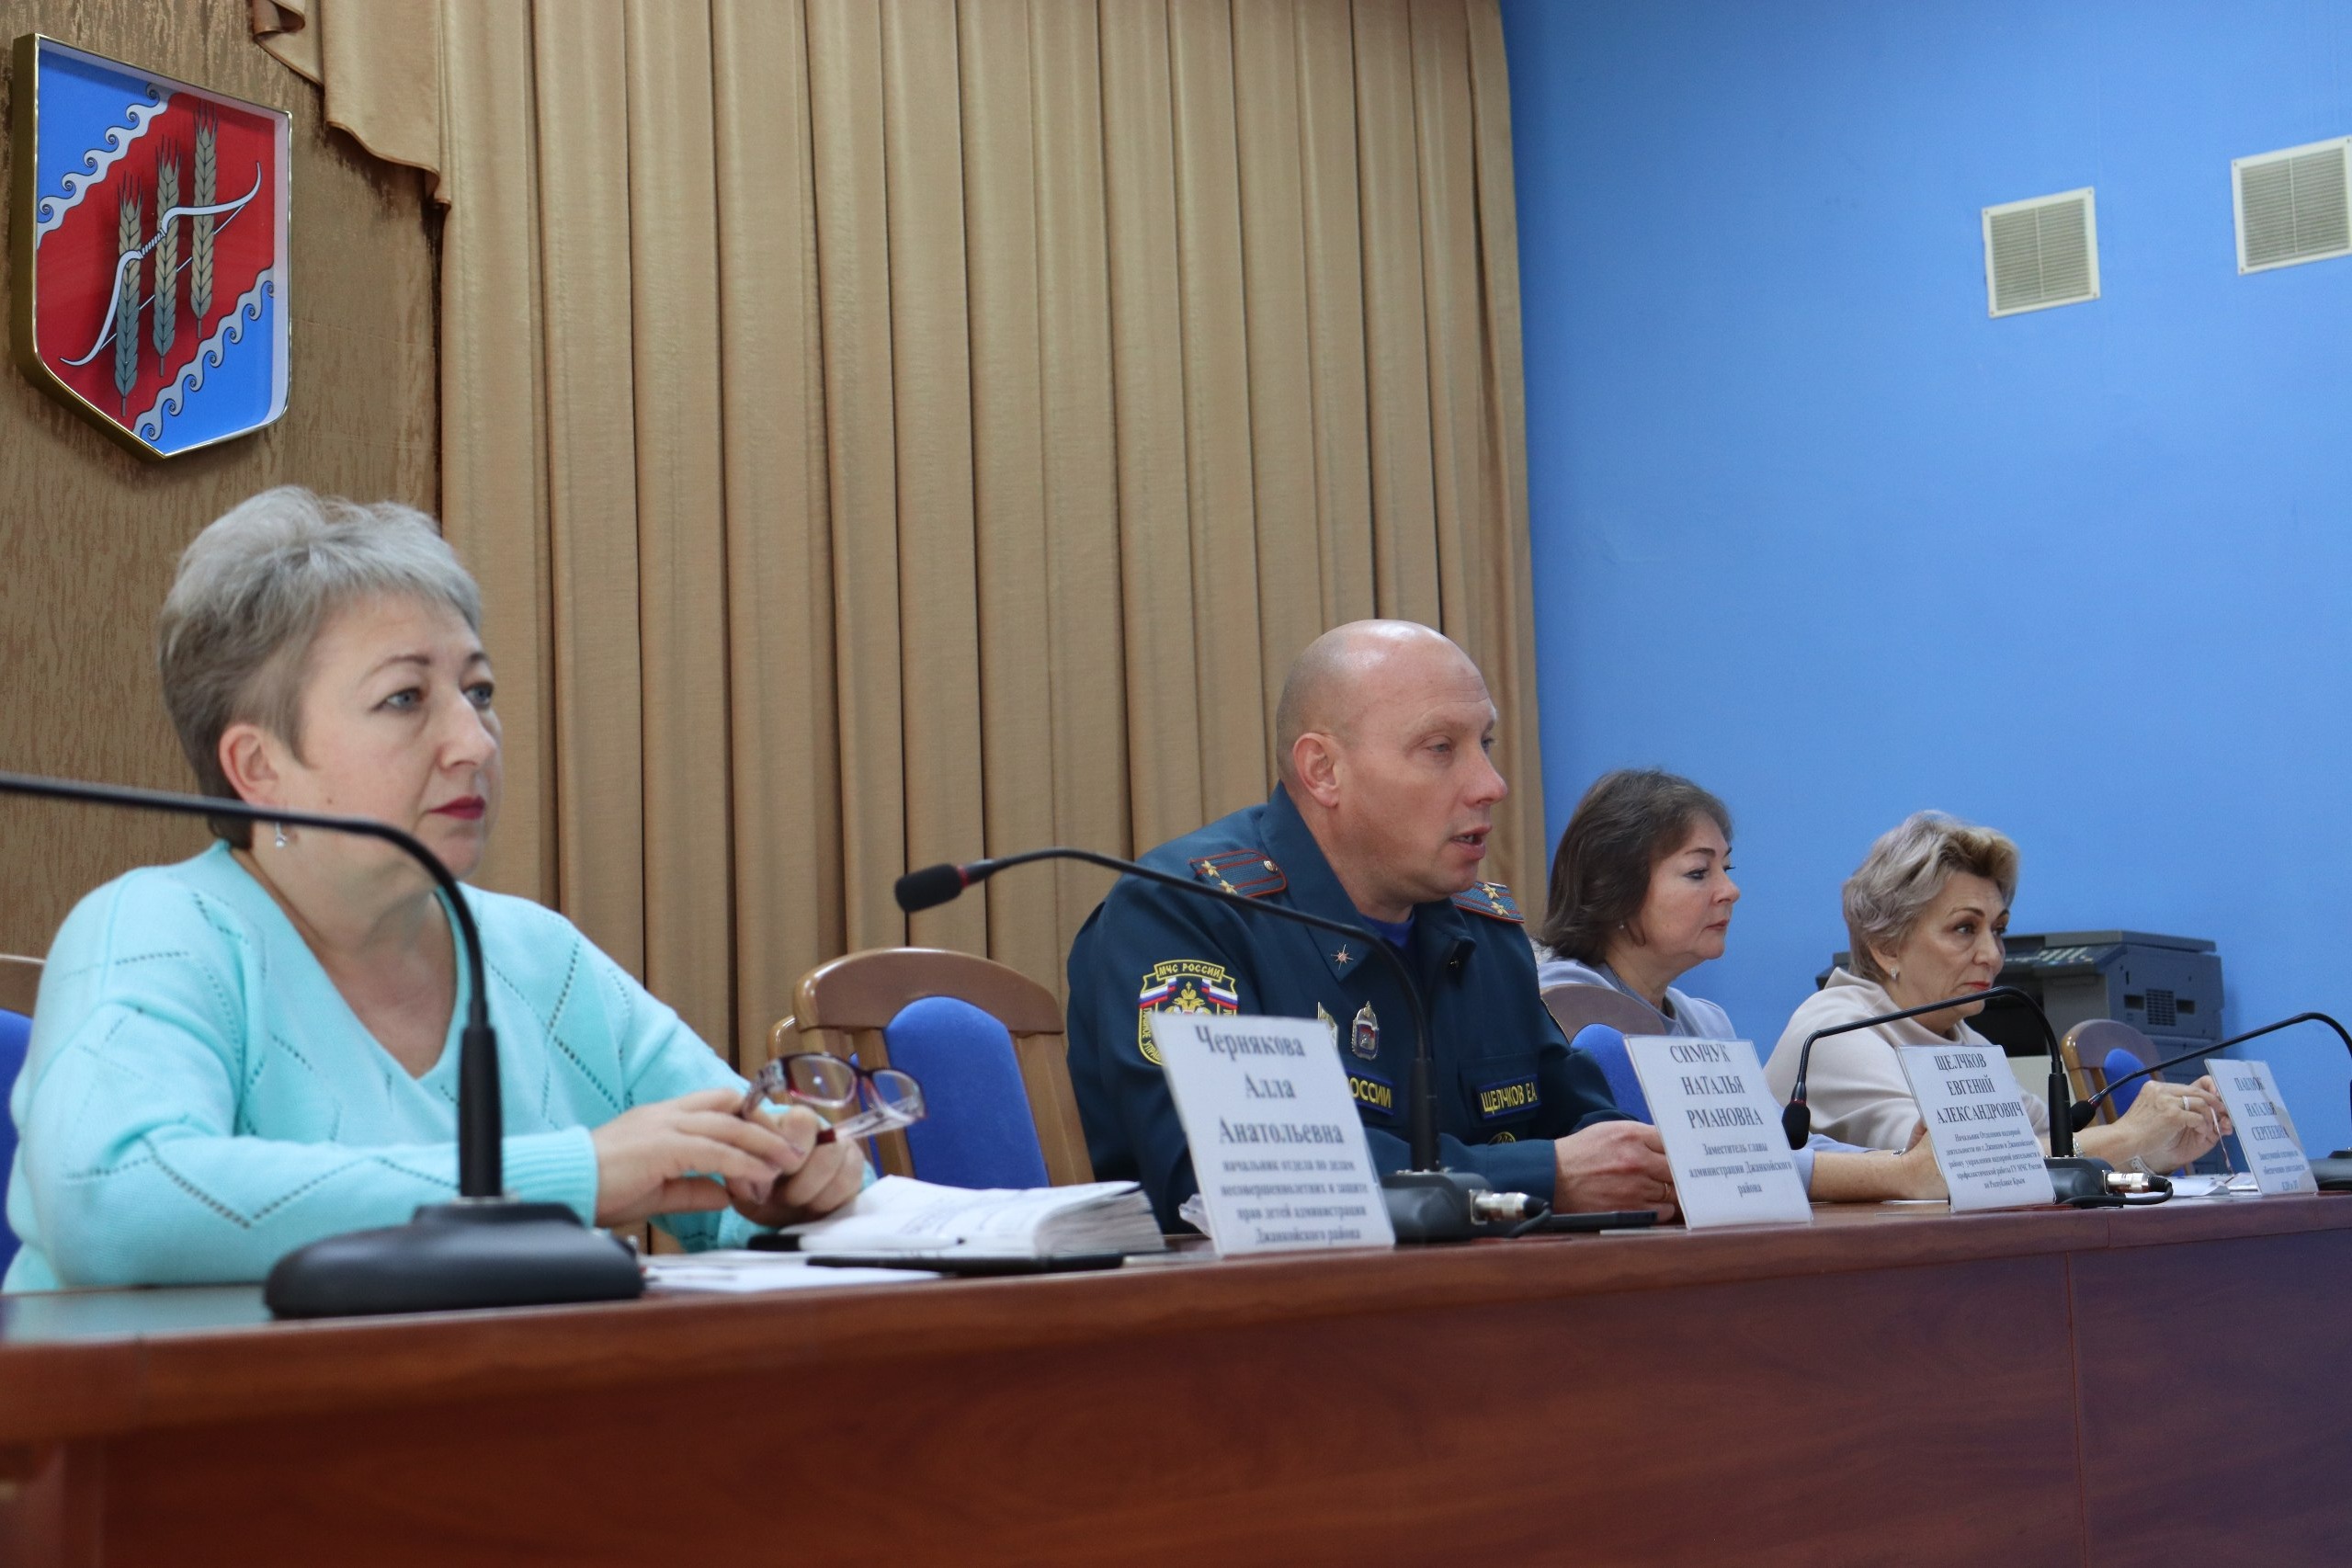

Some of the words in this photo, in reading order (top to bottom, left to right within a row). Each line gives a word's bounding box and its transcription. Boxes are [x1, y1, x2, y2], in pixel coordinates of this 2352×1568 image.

[1158, 963, 1178, 975] МЧС
[1182, 963, 1221, 976] РОССИИ
[1195, 1025, 1305, 1062] Чернякова
[1670, 1044, 1731, 1063] СИМЧУК
[1934, 1053, 1987, 1072] ЩЕЛЧКОВ
[1245, 1074, 1296, 1099] Алла
[1348, 1076, 1392, 1108] ОССИИ
[1682, 1075, 1745, 1096] НАТАЛЬЯ
[1946, 1074, 1995, 1096] ЕВГЕНИЙ
[1481, 1085, 1525, 1115] ЩЕЛЧКОВ
[1687, 1107, 1764, 1129] РМАНОВНА
[1937, 1101, 2024, 1124] АЛЕКСАНДРОВИЧ
[1219, 1116, 1345, 1144] Анатольевна
[1703, 1144, 1745, 1155] Заместитель
[1747, 1142, 1767, 1153] главы
[1689, 1164, 1744, 1177] администрации
[1745, 1161, 1792, 1175] Джанкойского
[1738, 1183, 1762, 1197] района
